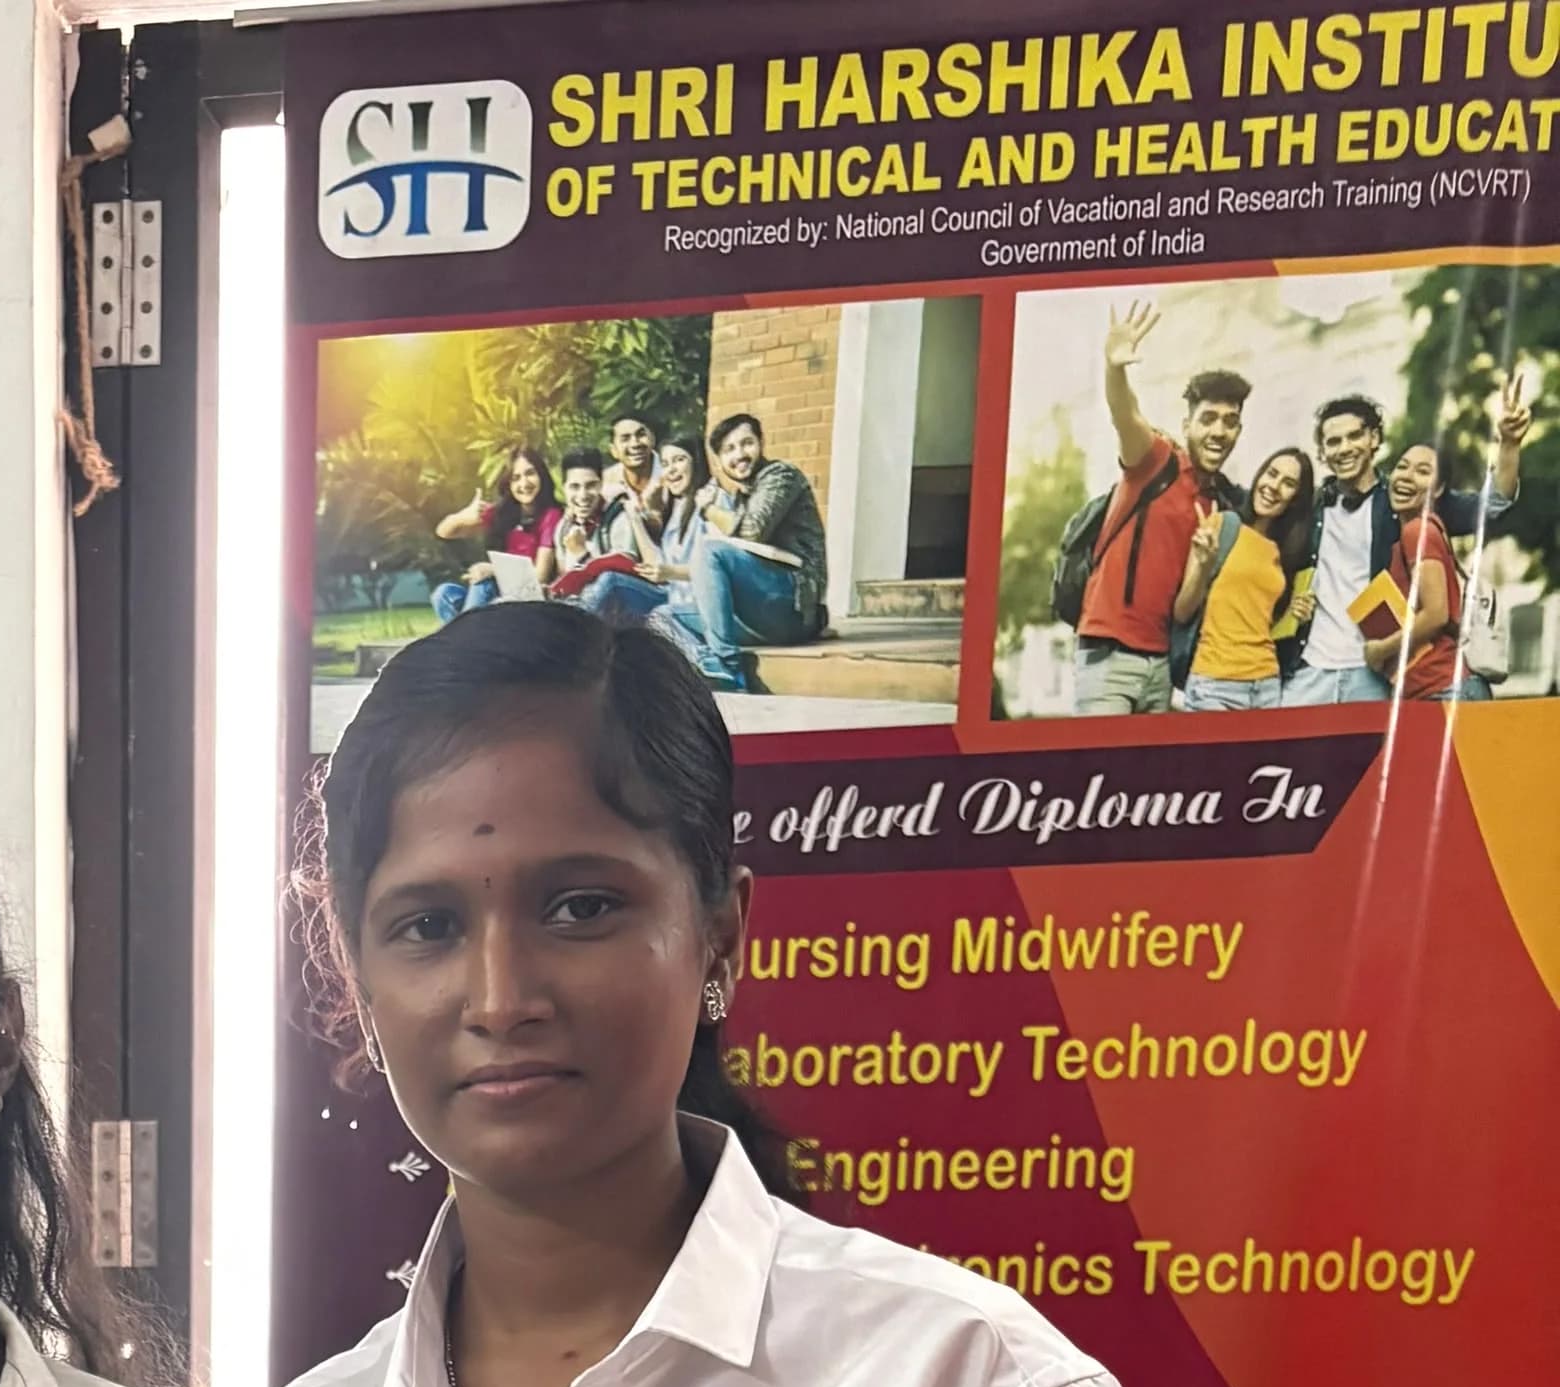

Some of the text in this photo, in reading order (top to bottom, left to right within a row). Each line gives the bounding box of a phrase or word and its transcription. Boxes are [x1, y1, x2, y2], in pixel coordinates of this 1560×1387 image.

[547, 1, 1560, 148] SHRI HARSHIKA INSTITU
[547, 165, 615, 218] OF
[632, 140, 942, 212] TECHNICAL
[957, 132, 1076, 189] AND
[1094, 113, 1318, 179] HEALTH
[664, 168, 1533, 254] Recognized by: National Council of Vacational and Research Training (NCVRT)
[980, 228, 1206, 267] Government of India
[769, 781, 945, 853] offerd
[958, 774, 1225, 845] Diploma
[1241, 764, 1328, 823] In
[736, 909, 1244, 990] ursing Midwifery
[1022, 1018, 1369, 1088] Technology
[786, 1133, 1135, 1206] Engineering
[1134, 1237, 1476, 1305] Technology
